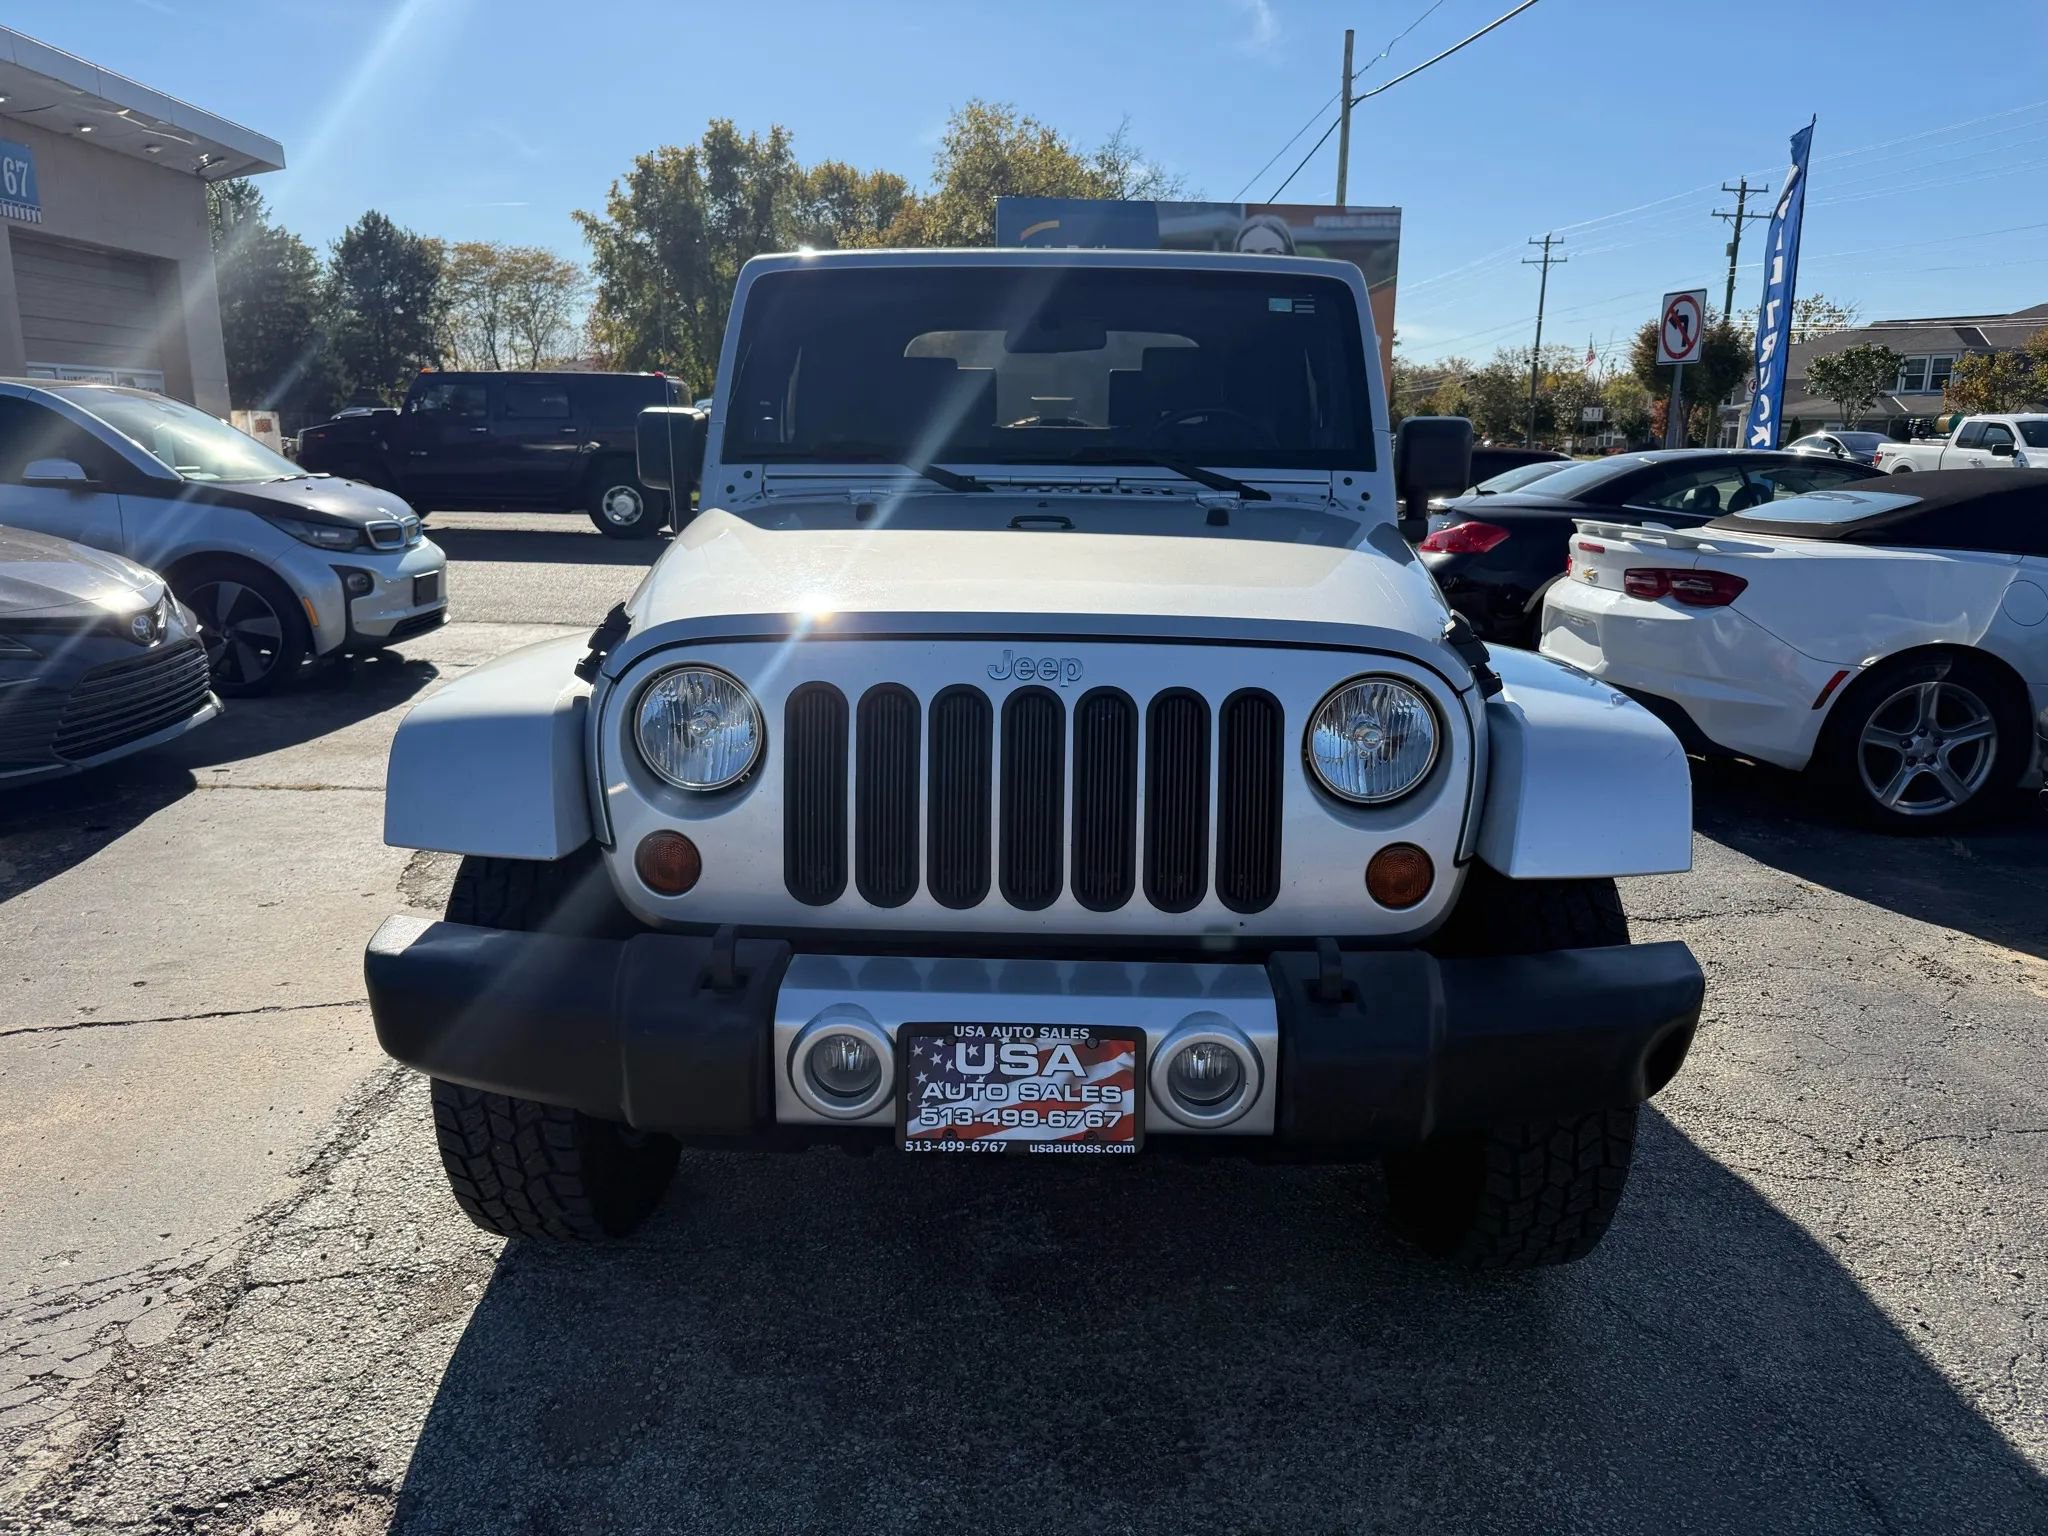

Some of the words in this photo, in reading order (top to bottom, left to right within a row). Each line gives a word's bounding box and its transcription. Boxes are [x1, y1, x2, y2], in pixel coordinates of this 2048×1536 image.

[987, 649, 1083, 687] Jeep
[953, 1025, 984, 1038] USA
[991, 1026, 1035, 1039] AUTO
[1039, 1027, 1090, 1040] SALES
[954, 1042, 1087, 1077] USA
[920, 1082, 1009, 1101] AUTO
[1018, 1082, 1123, 1104] SALES
[920, 1107, 1123, 1128] 513-499-6767
[904, 1140, 1008, 1152] 513-499-6767
[1029, 1142, 1136, 1155] usaautoss.com
